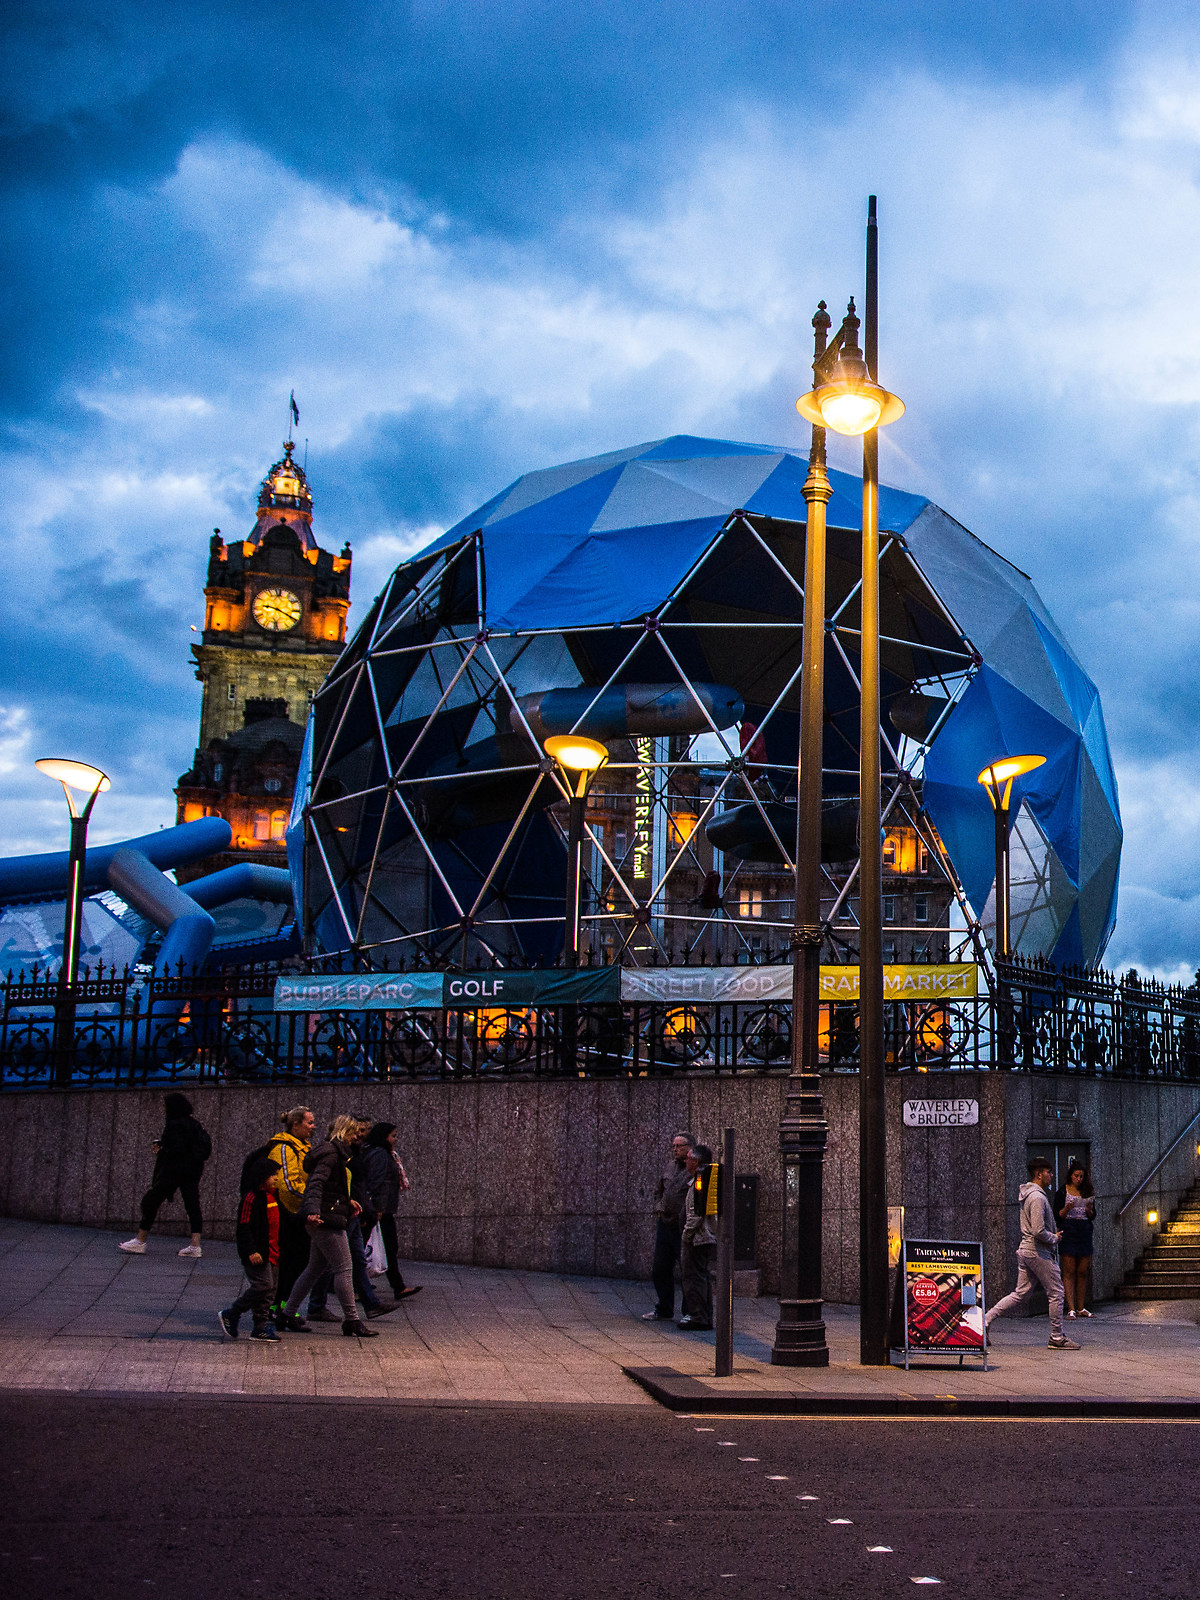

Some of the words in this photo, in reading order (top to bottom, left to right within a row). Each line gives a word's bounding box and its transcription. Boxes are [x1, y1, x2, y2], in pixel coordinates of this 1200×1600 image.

[633, 854, 646, 879] mall
[449, 979, 504, 997] GOLF
[627, 975, 706, 995] STREET
[713, 975, 775, 993] FOOD
[884, 973, 971, 991] MARKET
[279, 982, 413, 1002] BUBBLEPARC
[908, 1100, 975, 1112] WAVERLEY
[917, 1113, 965, 1125] BRIDGE
[914, 1248, 942, 1257] TARTAN
[947, 1249, 970, 1258] HOUSE
[915, 1289, 937, 1297] £5.84
